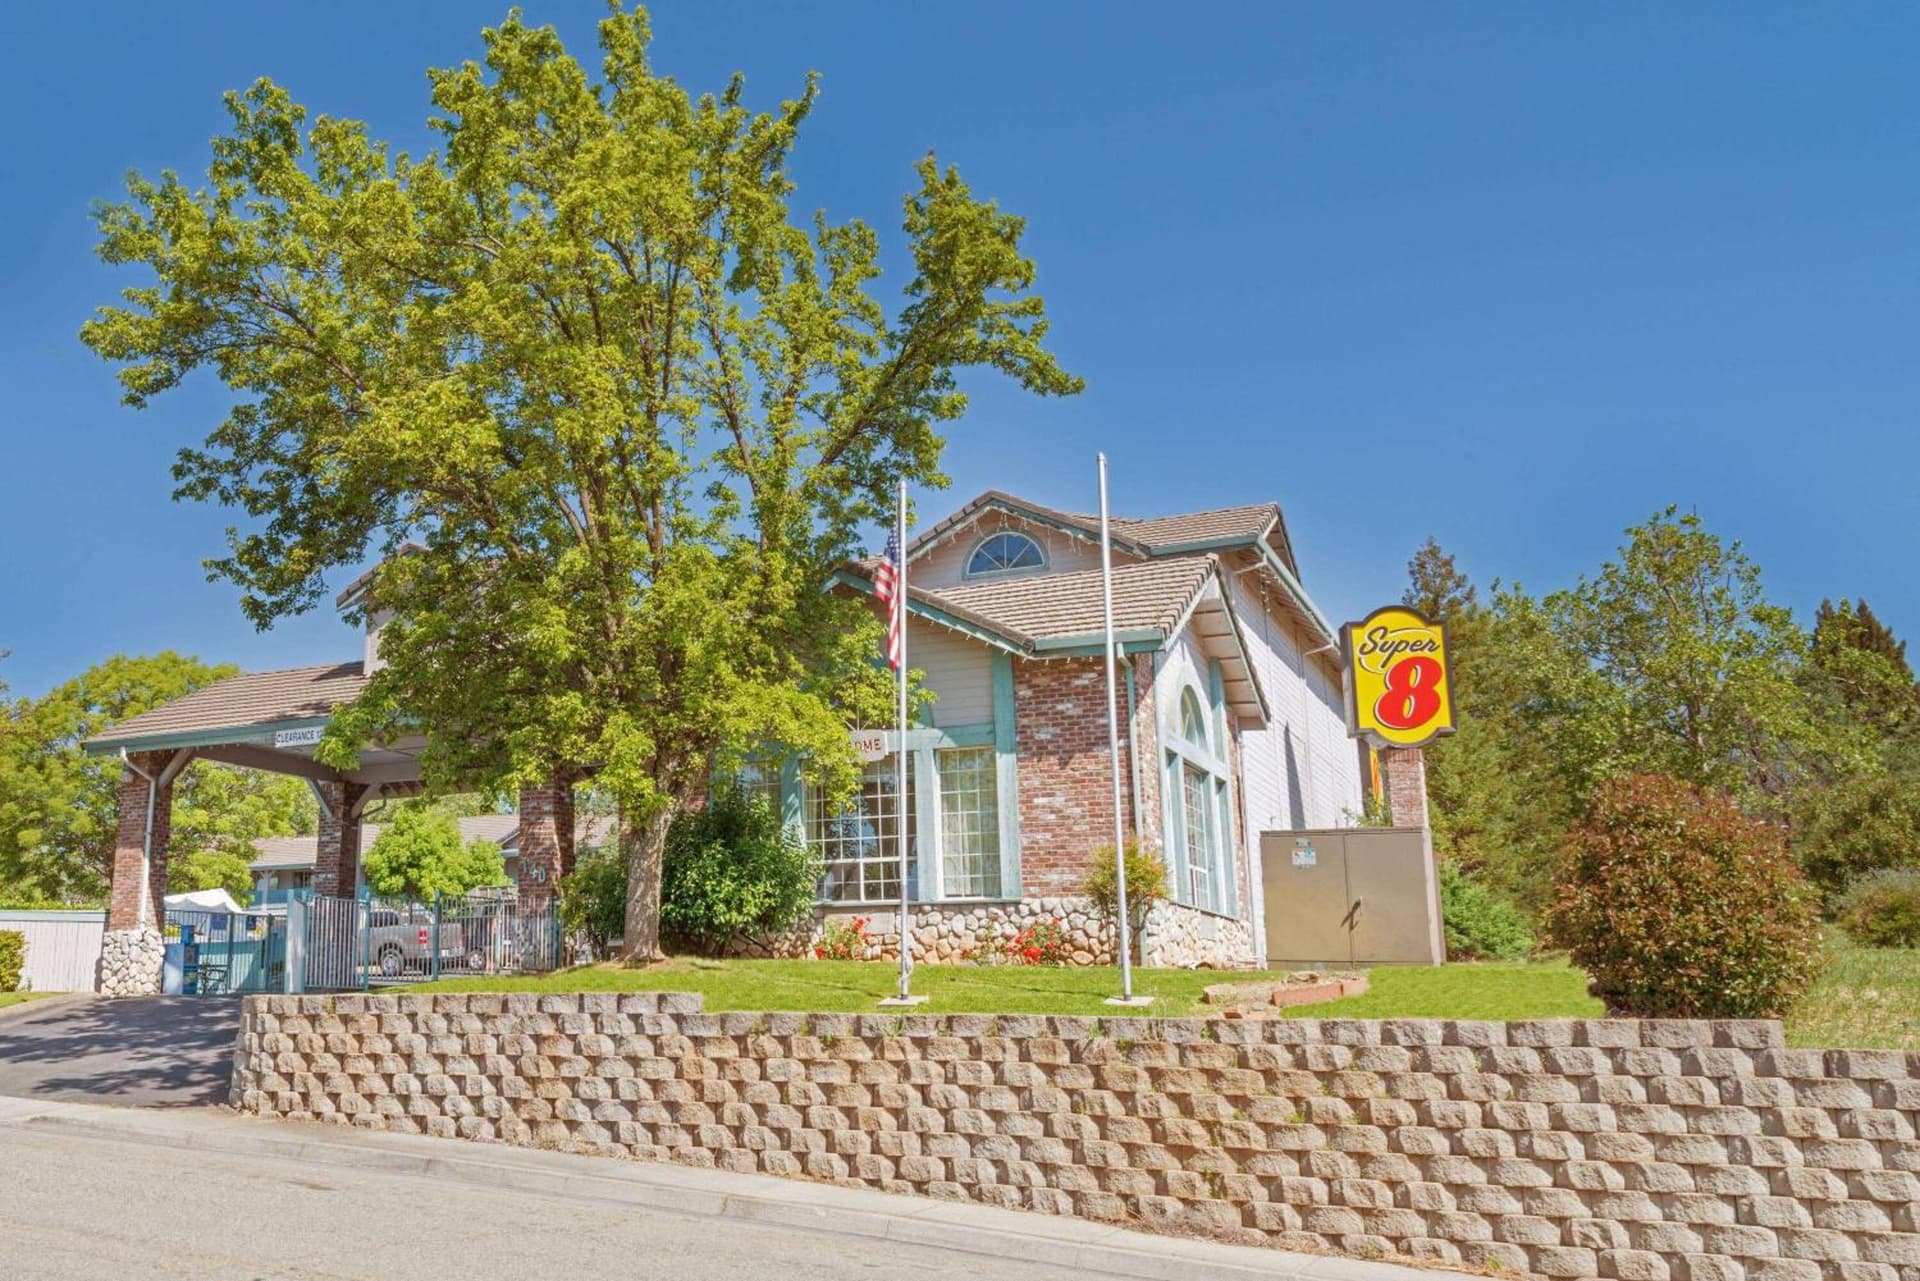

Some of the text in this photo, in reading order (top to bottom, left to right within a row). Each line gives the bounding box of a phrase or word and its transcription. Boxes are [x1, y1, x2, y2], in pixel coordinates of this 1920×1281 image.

[1359, 626, 1440, 669] Super
[1373, 656, 1443, 730] 8
[276, 730, 315, 743] CLEARANCE
